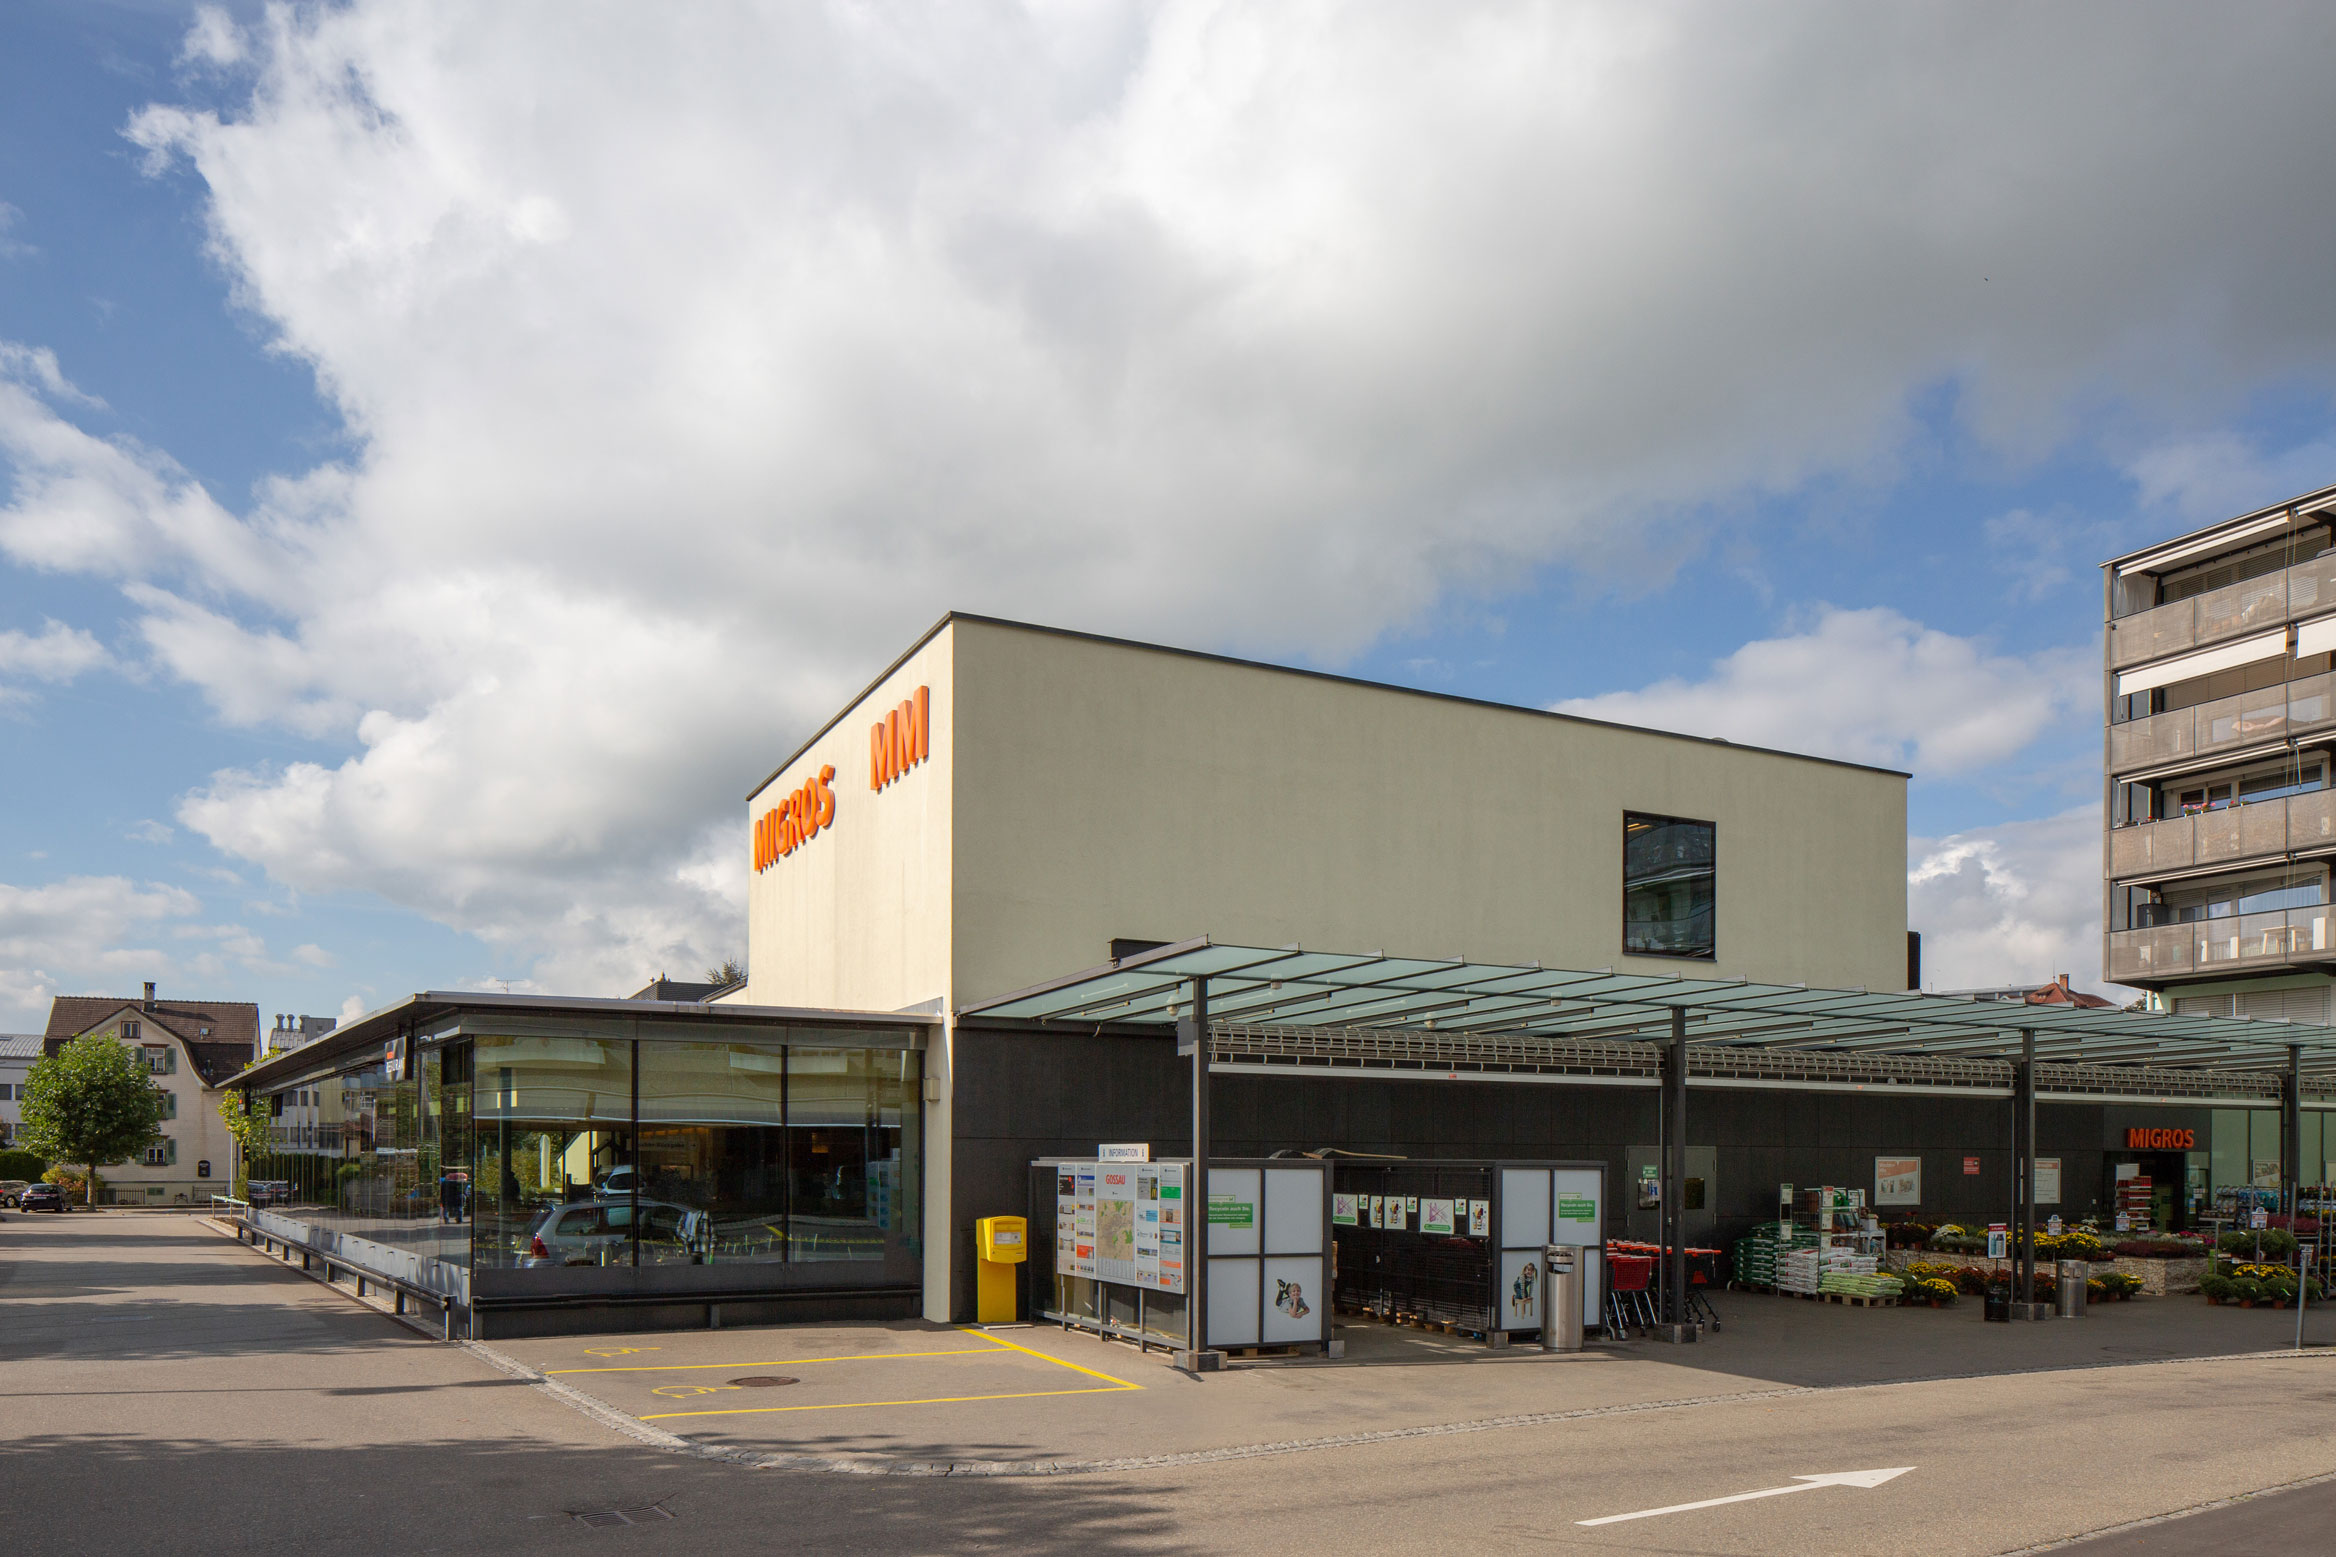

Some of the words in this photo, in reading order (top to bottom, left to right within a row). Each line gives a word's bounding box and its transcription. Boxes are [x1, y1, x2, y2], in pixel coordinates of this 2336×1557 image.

[754, 764, 835, 873] MIGROS
[870, 685, 929, 792] MM
[2128, 1128, 2194, 1149] MIGROS
[1109, 1148, 1138, 1157] INFORMATION
[1105, 1174, 1126, 1185] GOSSAU
